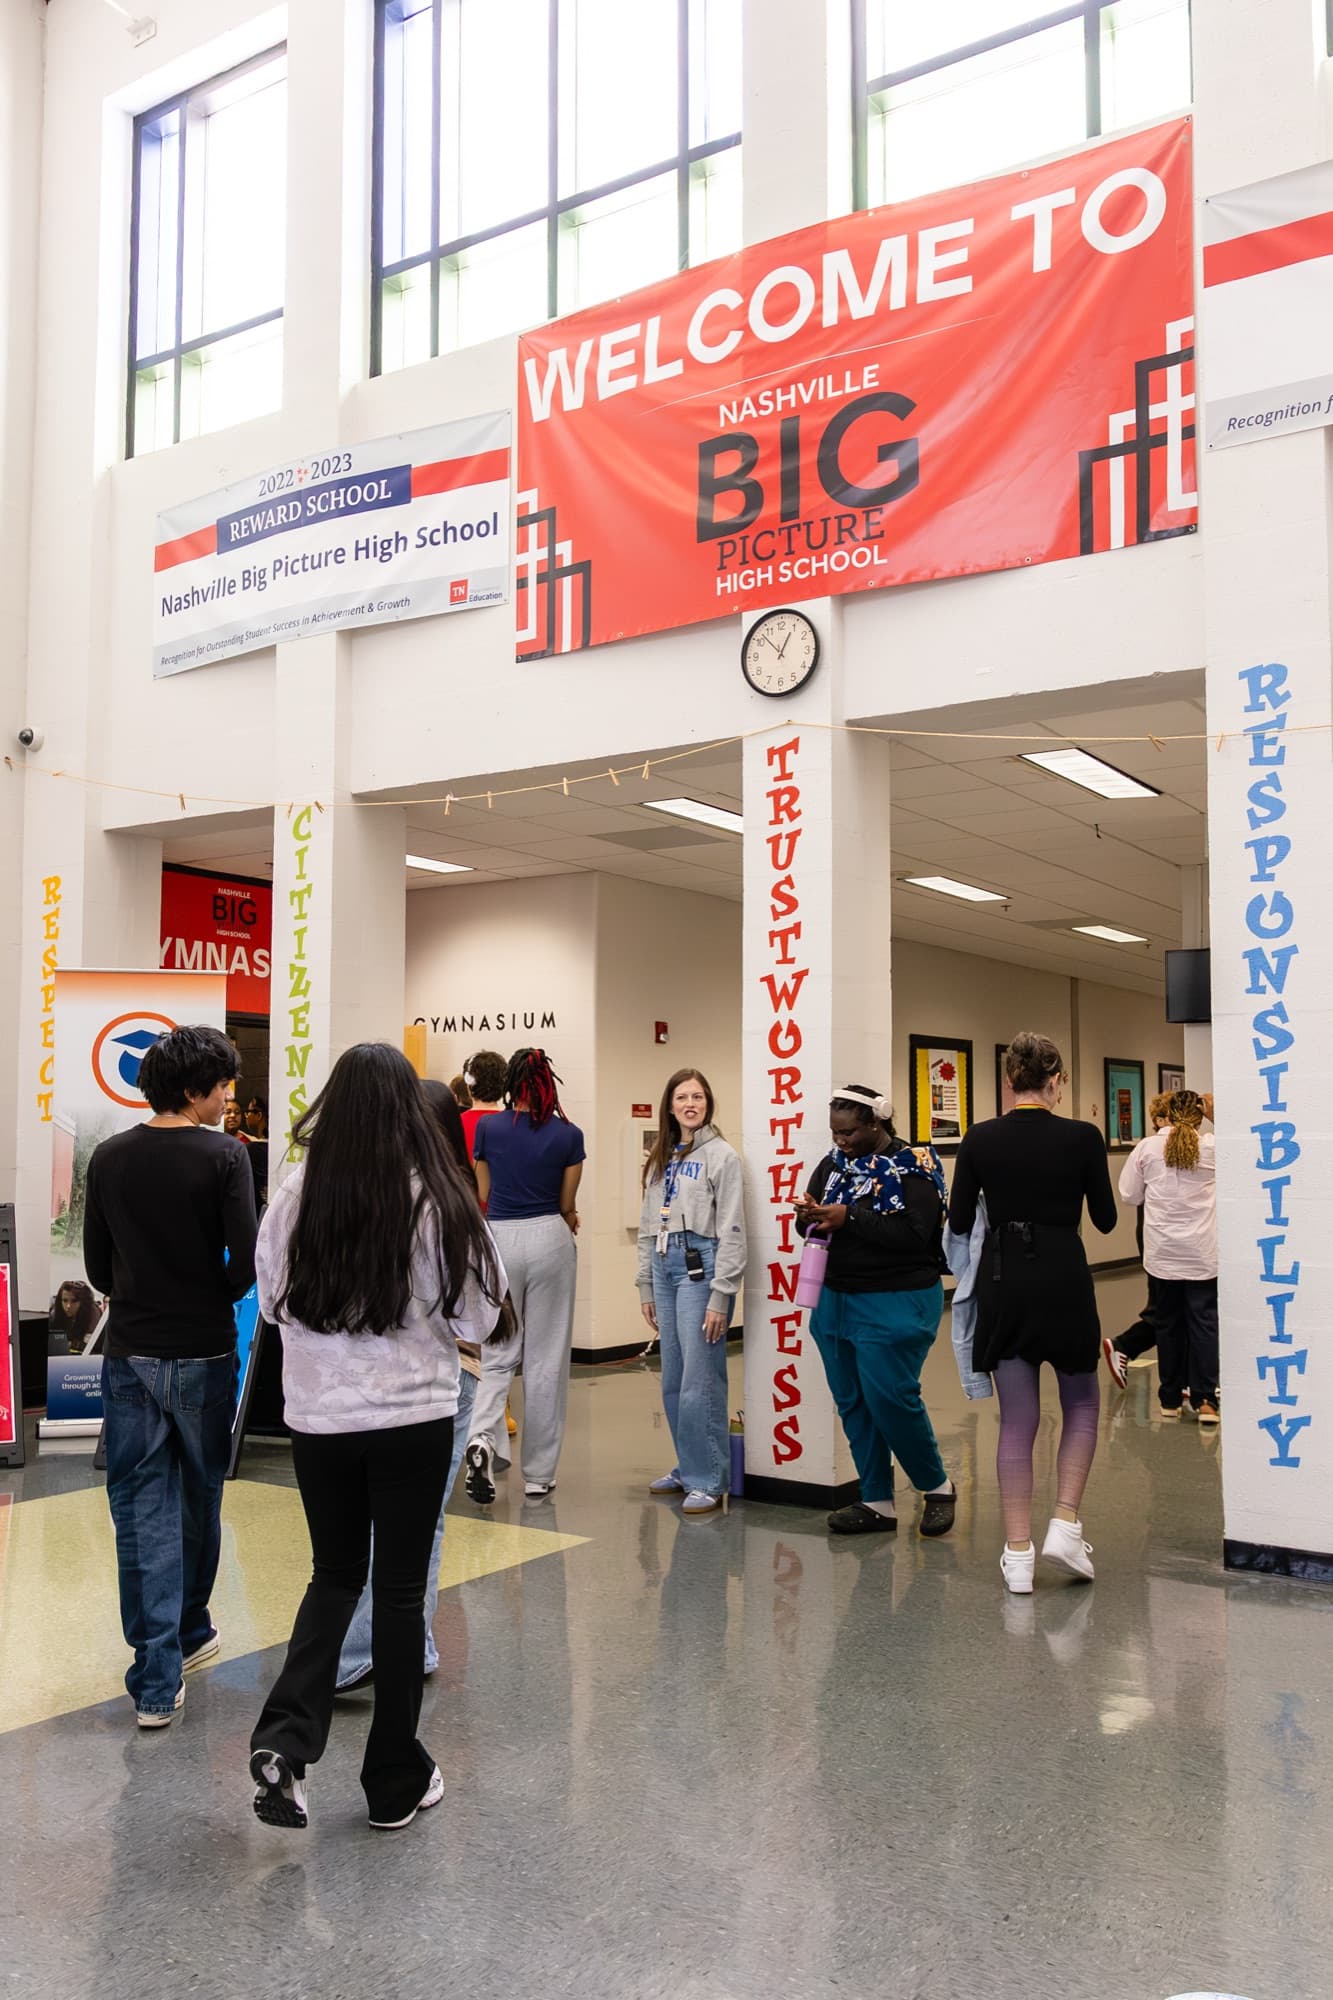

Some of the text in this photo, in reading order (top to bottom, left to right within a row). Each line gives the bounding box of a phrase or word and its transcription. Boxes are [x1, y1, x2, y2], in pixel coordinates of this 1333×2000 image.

[523, 166, 1167, 423] WELCOME TO
[719, 364, 880, 427] NASHVILLE
[1227, 401, 1321, 431] Recognition
[697, 391, 919, 544] BIG
[258, 453, 352, 497] 2022 2023
[230, 479, 392, 542] REWARD SCHOOL
[717, 507, 885, 571] PICTURE
[161, 511, 498, 616] Nashville Big Picture High School
[716, 545, 888, 596] HIGH SCHOOL
[452, 585, 466, 597] TN
[469, 591, 503, 602] Education
[161, 597, 411, 666] Recognition for Outstanding Student Success in Achievement & Growth
[766, 627, 773, 636] 11
[777, 621, 786, 631] 12
[792, 623, 796, 632] 1
[801, 631, 807, 640] 2
[757, 638, 765, 647] 10
[804, 645, 810, 655] 3
[753, 652, 759, 661] 9
[800, 660, 806, 669] 4
[756, 666, 762, 676] 8
[790, 672, 797, 681] 5
[766, 675, 772, 684] 7
[777, 677, 784, 687] 6
[217, 887, 251, 899] NASHVILLE
[213, 895, 257, 926] BIG
[216, 929, 251, 939] HIGH SCHOOL
[1238, 663, 1312, 1468] RESPONSIBILITY
[760, 736, 810, 1465] TRUSTWORTHINESS
[64, 1374, 95, 1382] Growing
[62, 1382, 91, 1390] through
